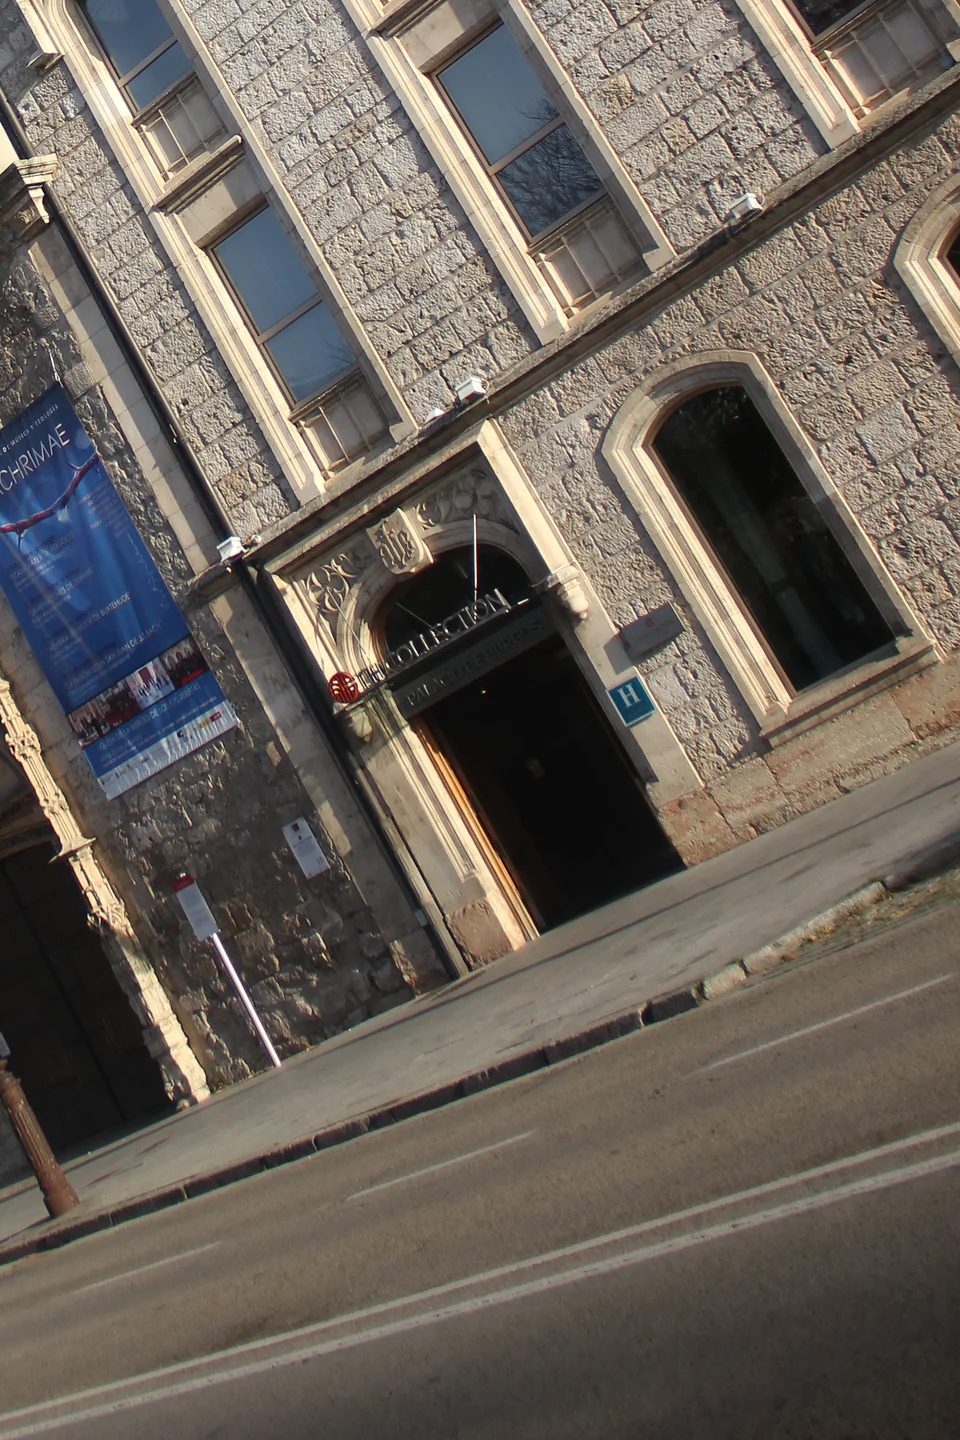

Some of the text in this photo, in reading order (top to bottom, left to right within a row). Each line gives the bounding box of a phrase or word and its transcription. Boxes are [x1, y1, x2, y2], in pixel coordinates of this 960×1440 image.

[129, 636, 138, 647] DE
[383, 588, 510, 670] COLLECTION
[405, 617, 542, 706] PALACIO DE BURGOS
[616, 676, 642, 709] H
[149, 708, 159, 718] DE
